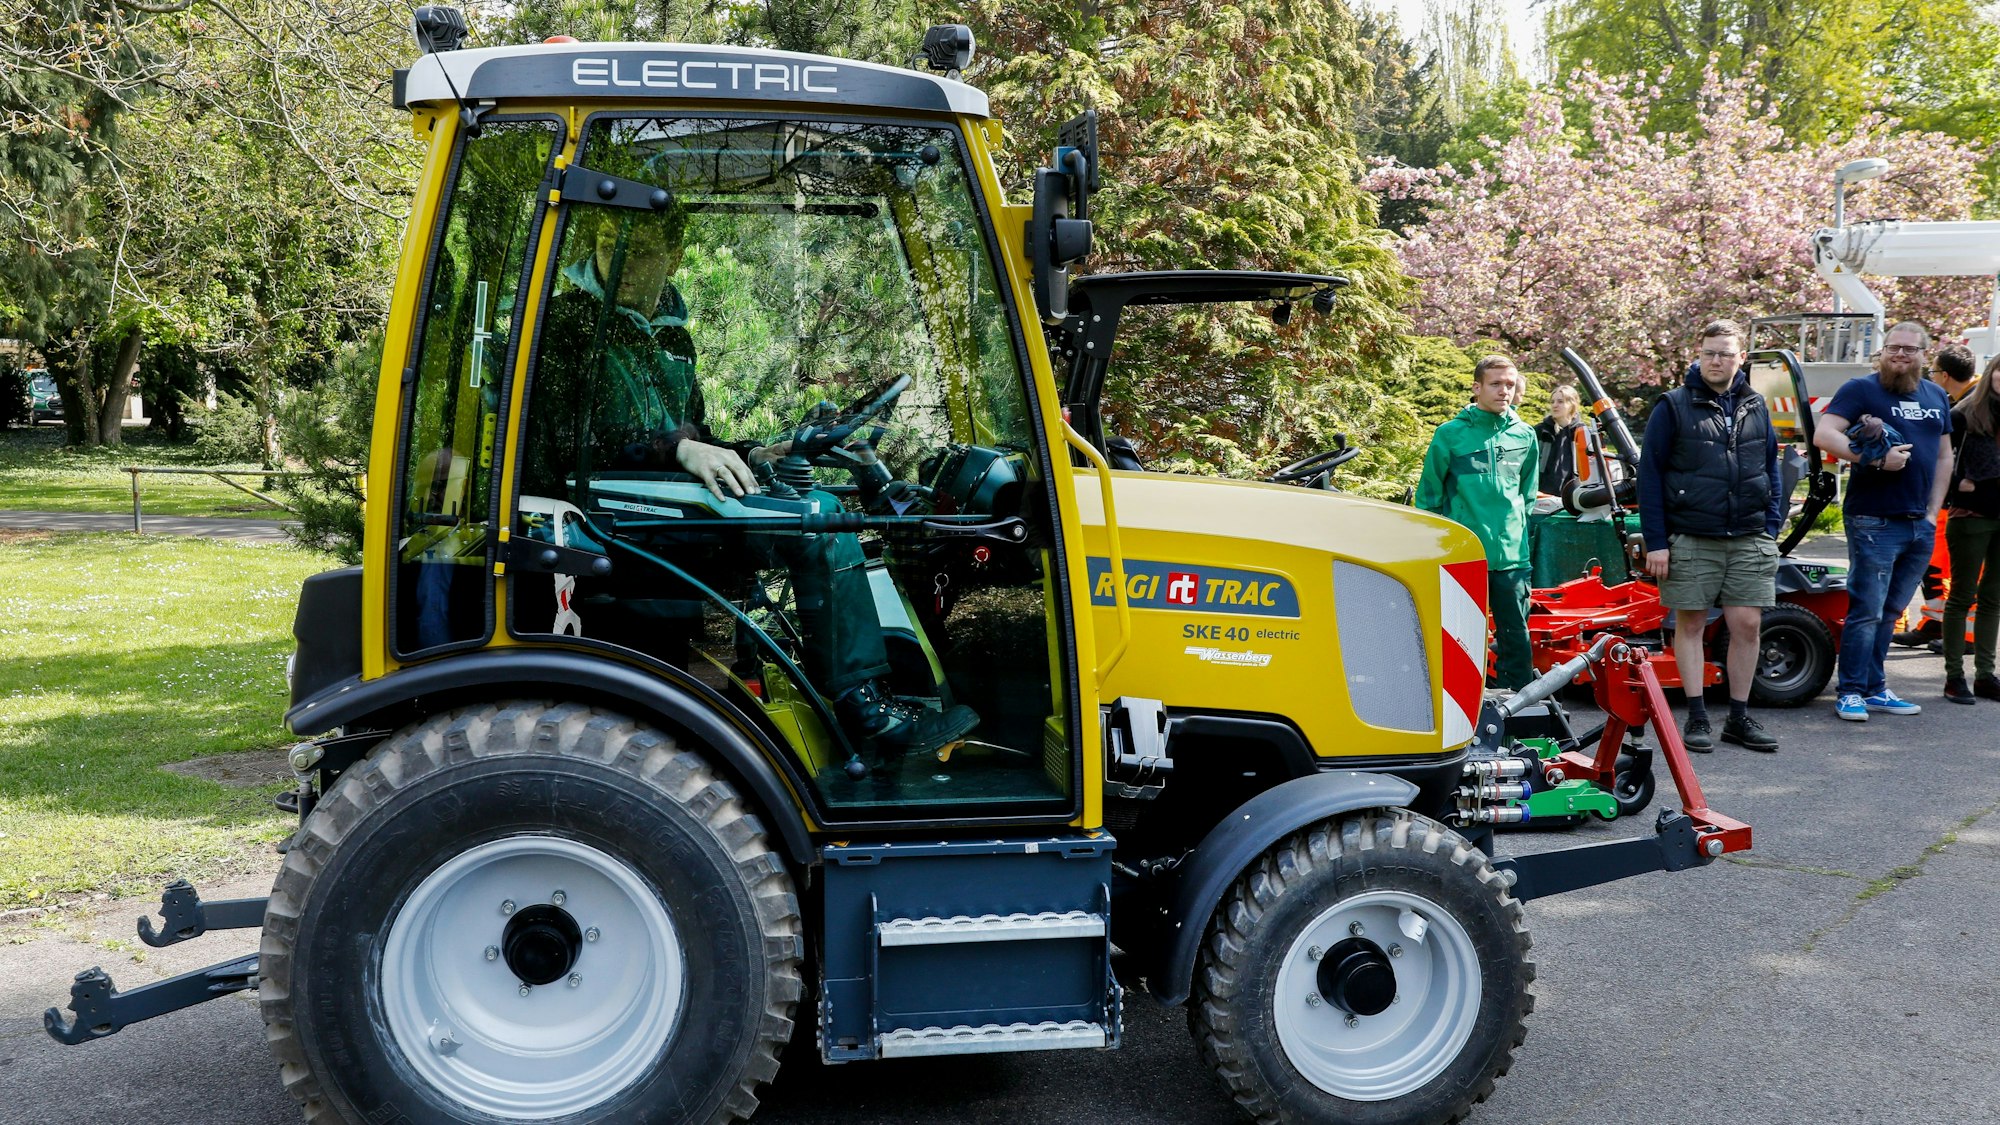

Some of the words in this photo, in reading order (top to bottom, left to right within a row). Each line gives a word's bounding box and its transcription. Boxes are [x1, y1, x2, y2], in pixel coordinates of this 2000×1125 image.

[572, 58, 838, 93] ELECTRIC
[1094, 572, 1161, 600] RGI
[1205, 578, 1283, 607] TRAC
[1182, 624, 1222, 640] SKE
[1224, 627, 1250, 642] 40
[1256, 628, 1301, 641] electric
[1198, 647, 1273, 667] Wassenberg
